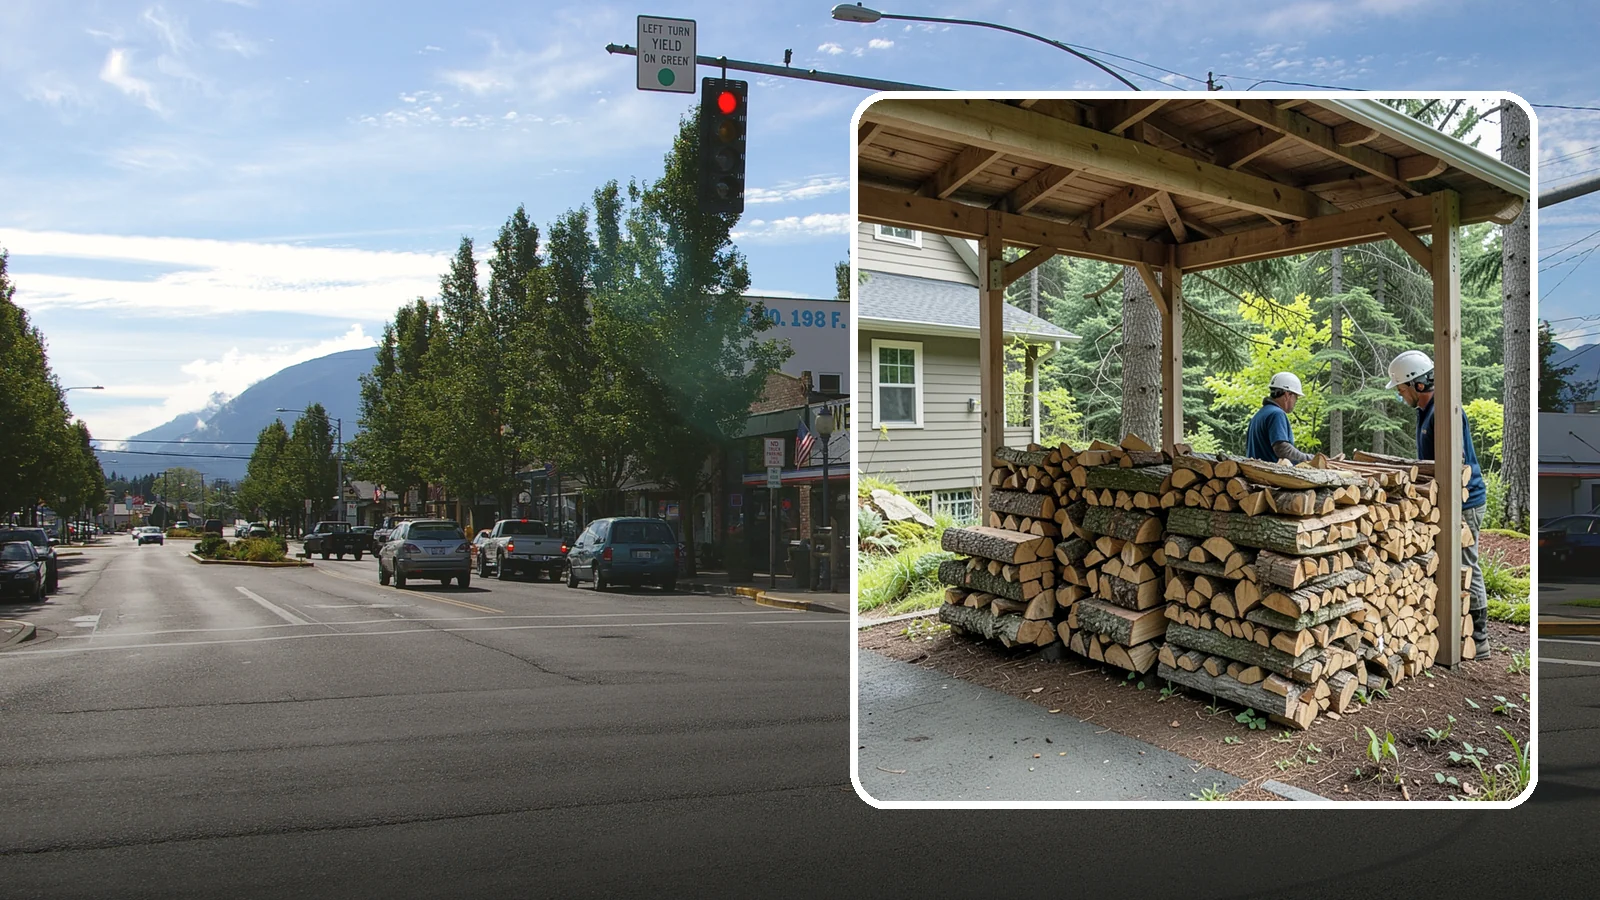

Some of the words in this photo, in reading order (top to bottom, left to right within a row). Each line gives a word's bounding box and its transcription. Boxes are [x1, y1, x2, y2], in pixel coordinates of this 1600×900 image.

[643, 23, 663, 34] LEFT
[668, 25, 690, 37] TURN
[652, 38, 682, 52] YIELD
[644, 53, 656, 64] ON
[661, 55, 689, 66] GREEN
[791, 309, 826, 328] 198
[832, 311, 846, 329] F.
